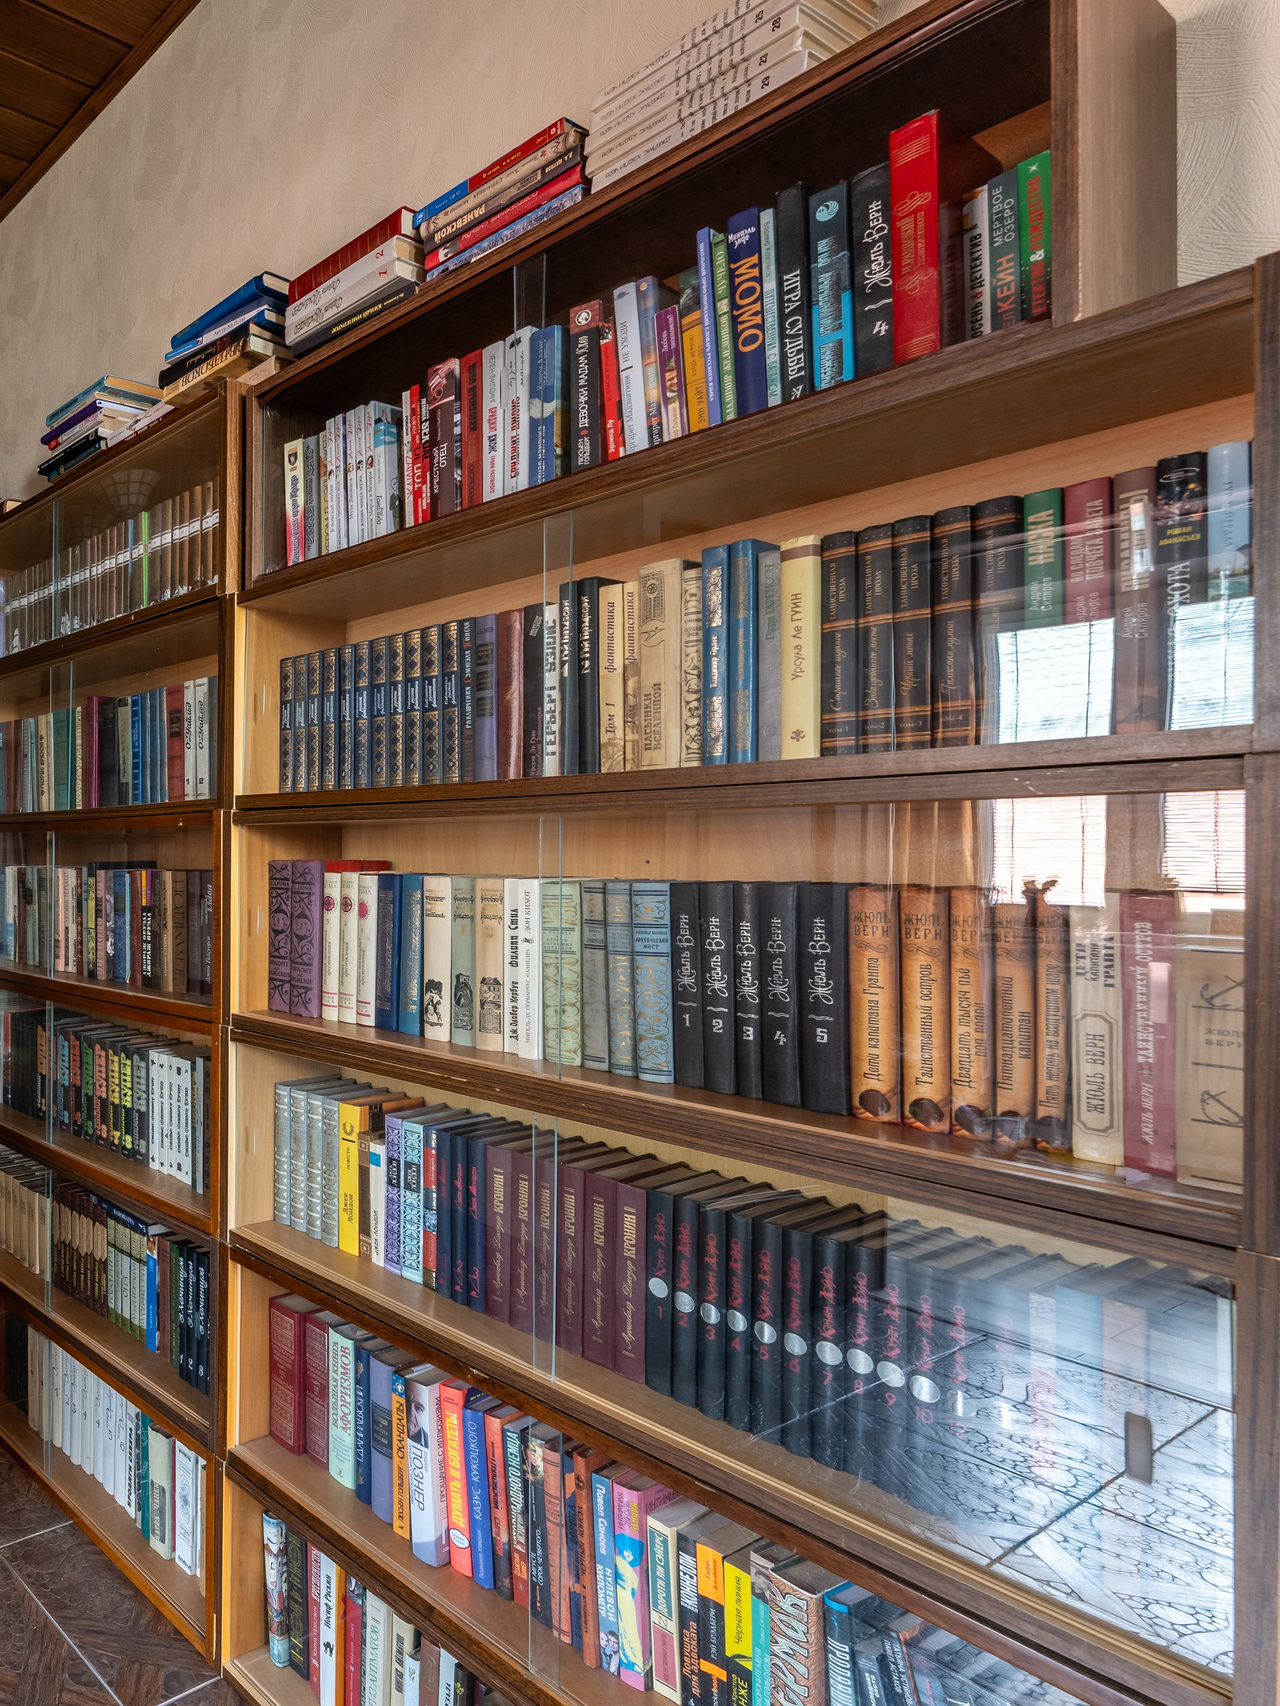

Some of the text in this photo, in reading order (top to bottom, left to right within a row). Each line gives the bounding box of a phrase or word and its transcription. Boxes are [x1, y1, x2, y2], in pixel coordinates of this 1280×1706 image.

[754, 9, 763, 24] 25
[771, 15, 781, 32] 28
[757, 52, 769, 67] 23
[759, 74, 770, 90] 29
[433, 203, 485, 243] РАНЕВСКОЙ
[991, 184, 1003, 247] МЕРТВОЕ
[1003, 196, 1015, 242] ОЗЕРО
[374, 248, 383, 261] 2
[714, 250, 727, 293] ЧУЧЕЛО
[729, 252, 763, 356] МОМО
[968, 231, 984, 339] ОСЕНЬ & ДЕТЕКТИВ
[991, 252, 1016, 314] КЕЙН
[619, 320, 630, 363] НЕ УХОДИ
[783, 269, 804, 381] ИГРА СУДЬБЫ
[695, 385, 706, 423] ЭНН УАЙТ
[439, 441, 448, 468] ОТЕЦ
[1026, 508, 1054, 565] НАСКА
[1070, 535, 1083, 582] ПО СЛЕДАМ
[1085, 498, 1103, 580] КОВЧЕГА ЗАВЕТА
[829, 562, 837, 619] ТАИНСТВЕННАЯ
[838, 577, 846, 601] ПРОЗА
[864, 554, 872, 614] ТАИНСТВЕННАЯ
[874, 570, 882, 595] ПРОЗА
[899, 546, 908, 607] ТАИНСТВЕННАЯ
[909, 562, 919, 588] ПРОЗА
[1028, 580, 1040, 610] Андрей
[1040, 576, 1052, 611] Скляров
[604, 600, 616, 673] фантастика
[625, 590, 636, 663] фантастика
[790, 592, 803, 680] Урсула Ле ГУИН
[605, 713, 615, 734] Том
[626, 704, 635, 725] Том
[643, 692, 652, 750] ПАСЫНКИ
[651, 682, 662, 750] ВСЕЛЕННОЙ
[523, 917, 531, 933] ДОН
[853, 910, 891, 923] ЖЮЛЬ
[854, 924, 889, 937] ВЕРН
[903, 913, 944, 926] ЖЮЛЬ
[905, 927, 942, 940] ВЕРН
[1089, 942, 1099, 981] КАПИТАНА
[1103, 935, 1115, 987] ГРАНТА
[862, 957, 884, 1081] Дети капитана Гранта
[914, 963, 937, 1085] Таинственный остров
[996, 976, 1015, 1090] Пятнадцатилетний
[1017, 1011, 1031, 1059] капитан
[1038, 962, 1065, 1107] Пять недель на воздушном шаре
[108, 1048, 119, 1106] КУПЕР
[120, 1050, 132, 1109] КУПЕР
[132, 1052, 146, 1113] КУПЕР
[1085, 1032, 1105, 1113] ЖЮЛЬ ВЕРН
[593, 1202, 604, 1246] КРОНИН
[623, 1213, 635, 1258] КРОНИН
[340, 1343, 351, 1437] АФОРИЗМОВ
[396, 1400, 404, 1460] СКАНДАЛЫ
[505, 1430, 520, 1468] НЕМЦА
[411, 1444, 425, 1512] ПОЗНЕР
[445, 1410, 464, 1527] ДУМАТЬ И БОГАТЕТЬ!
[467, 1420, 482, 1520] КАЗУС КУКОЦКОГО
[508, 1466, 522, 1506] ОДНОГО
[396, 1496, 404, 1523] ЛЮСЬЕН
[595, 1483, 607, 1555] Павел Санаев
[630, 1500, 638, 1533] ЛЕНИНА
[596, 1563, 606, 1618] КИЛОМЕТР
[604, 1567, 615, 1622] НУЛЕВОЙ
[652, 1531, 668, 1616] ДОРОТИ ЛИ СЭЙЕРС
[678, 1550, 697, 1607] КОННЕЛЛИ
[323, 1601, 332, 1629] Иосиф
[733, 1575, 744, 1645] Черная линия
[368, 1623, 378, 1686] АЙТМАТОВ
[394, 1632, 404, 1668] АЙТМАТОВ
[682, 1628, 690, 1678] Ловушка
[689, 1621, 700, 1696] для адвоката
[709, 1644, 717, 1659] РЭЙ
